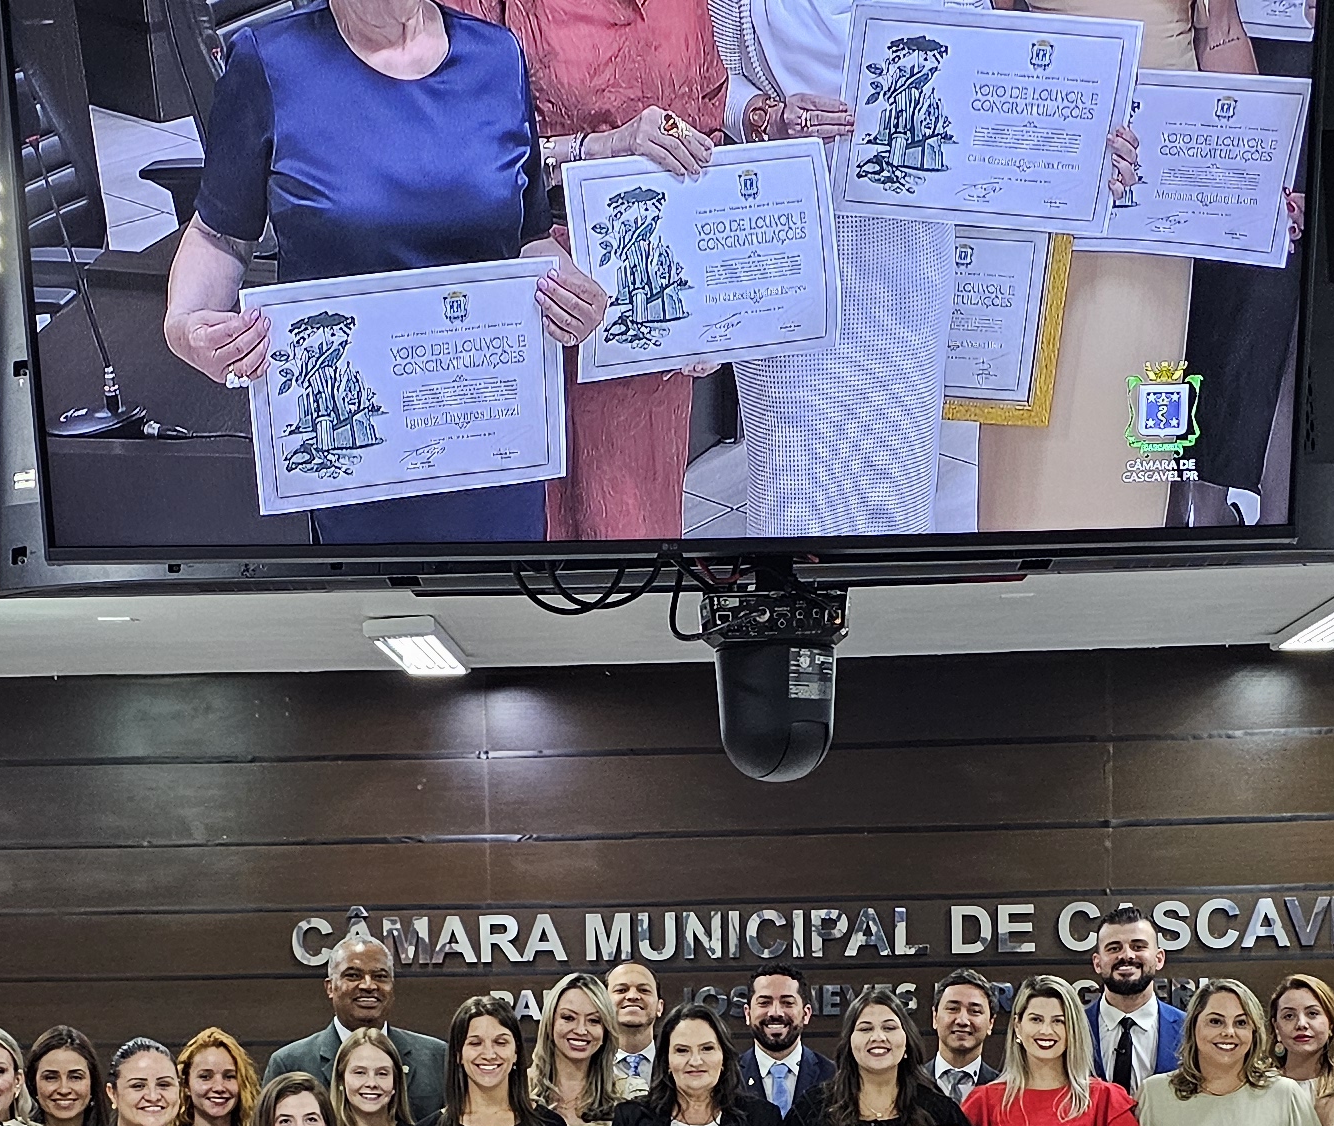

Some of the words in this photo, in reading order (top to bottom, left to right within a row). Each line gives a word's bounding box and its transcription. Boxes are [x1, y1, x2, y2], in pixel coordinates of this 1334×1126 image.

[973, 83, 1006, 98] VOTO
[1009, 85, 1028, 99] DE
[1032, 88, 1084, 105] LOUVOR
[1090, 92, 1098, 105] E
[971, 99, 1095, 122] CONGRATULAÇÕES
[1161, 131, 1192, 146] VOTO
[1195, 134, 1212, 146] DE
[1215, 135, 1265, 149] LOUVOR
[1270, 139, 1277, 150] E
[1159, 146, 1274, 163] CONGRATULAÇÕES
[695, 219, 726, 236] VOTO
[729, 218, 746, 232] DE
[749, 214, 797, 230] LOUVOR
[799, 212, 806, 224] E
[697, 226, 807, 252] CONGRATULAÇÕES
[390, 343, 427, 362] VOTO
[431, 342, 451, 357] DE
[454, 337, 510, 355] LOUVOR
[517, 334, 527, 348] E
[392, 349, 526, 377] CONGRATULAÇÕES
[1127, 458, 1177, 470] CÂMARA
[1180, 459, 1196, 469] DE
[1122, 471, 1181, 482] CASCAVEL
[1183, 471, 1198, 481] PR
[585, 907, 929, 962] MUNICIPAL
[950, 903, 1036, 955] DE
